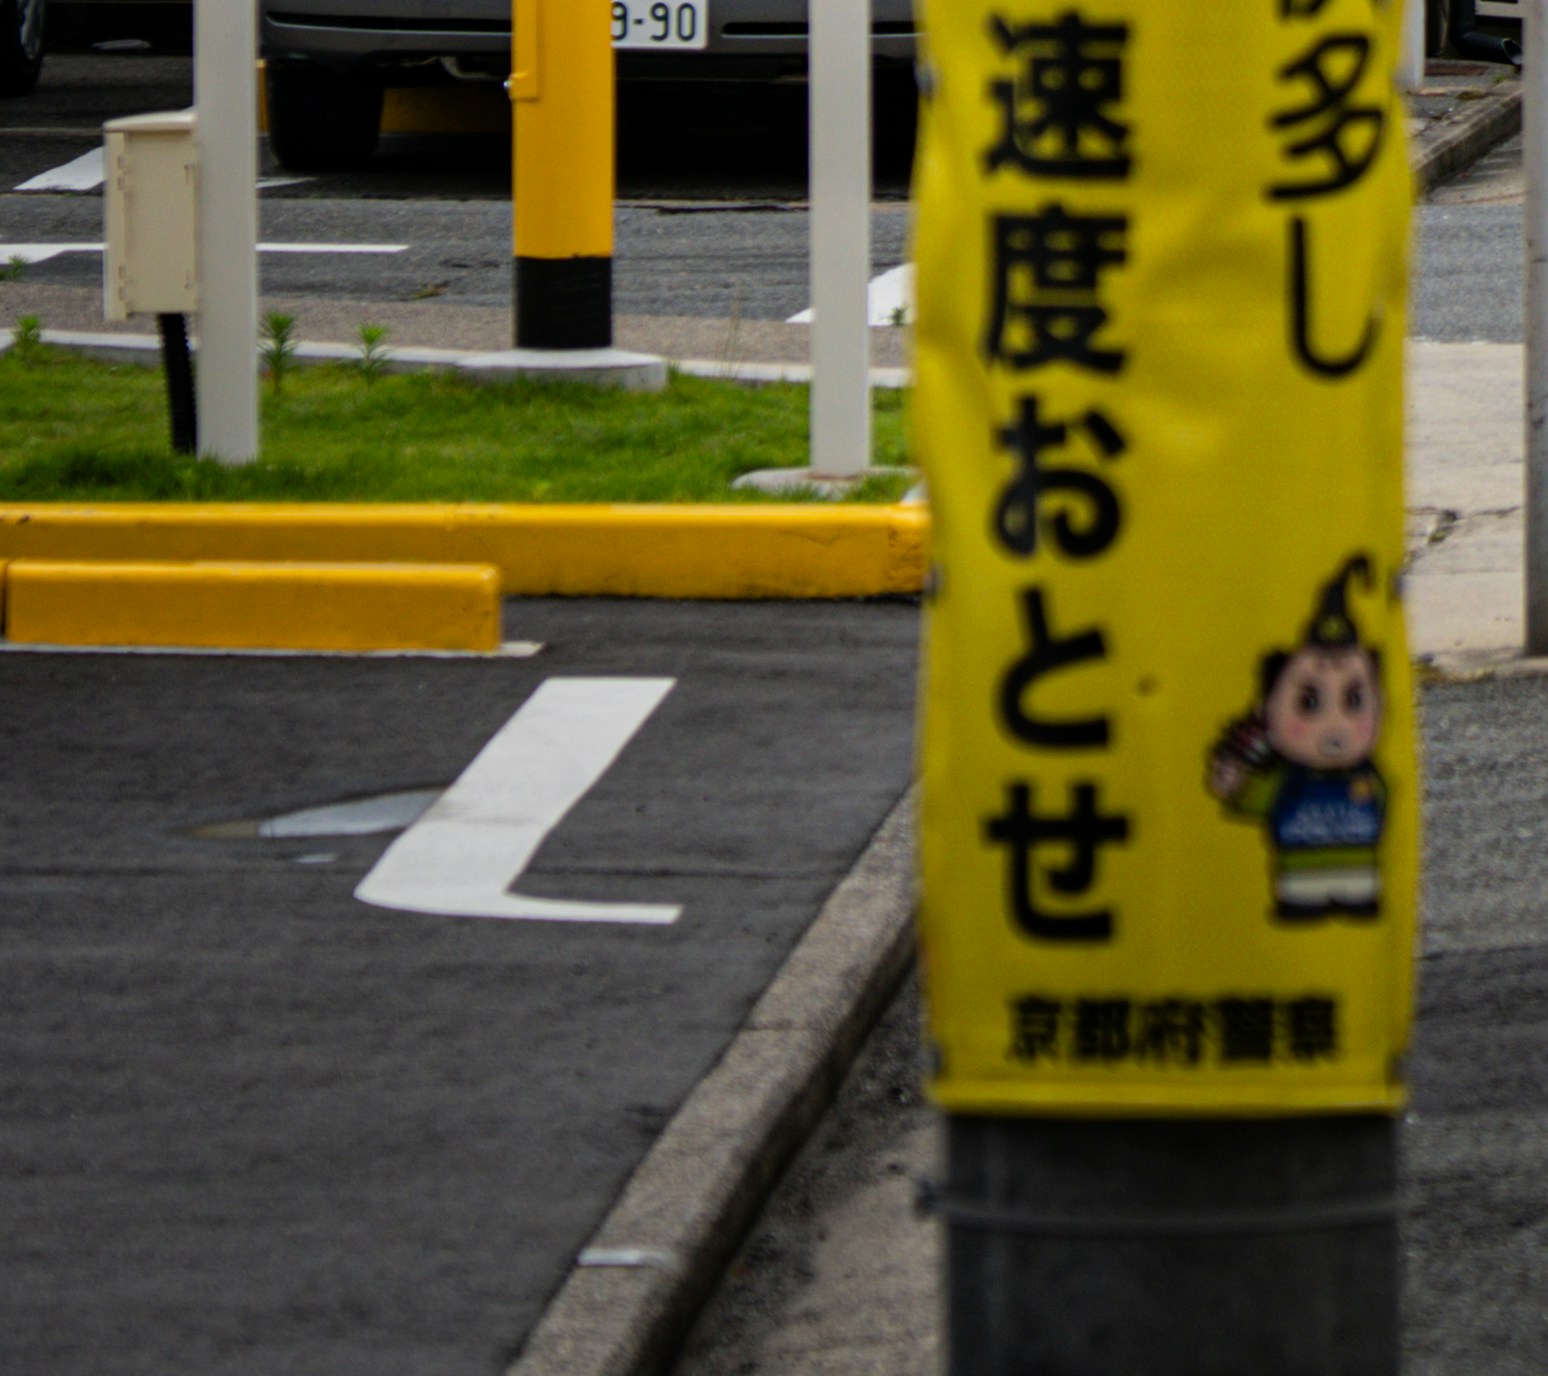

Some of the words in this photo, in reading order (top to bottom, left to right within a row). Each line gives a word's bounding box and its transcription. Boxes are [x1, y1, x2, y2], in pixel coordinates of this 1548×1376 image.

[981, 9, 1137, 945] 速度おとせ
